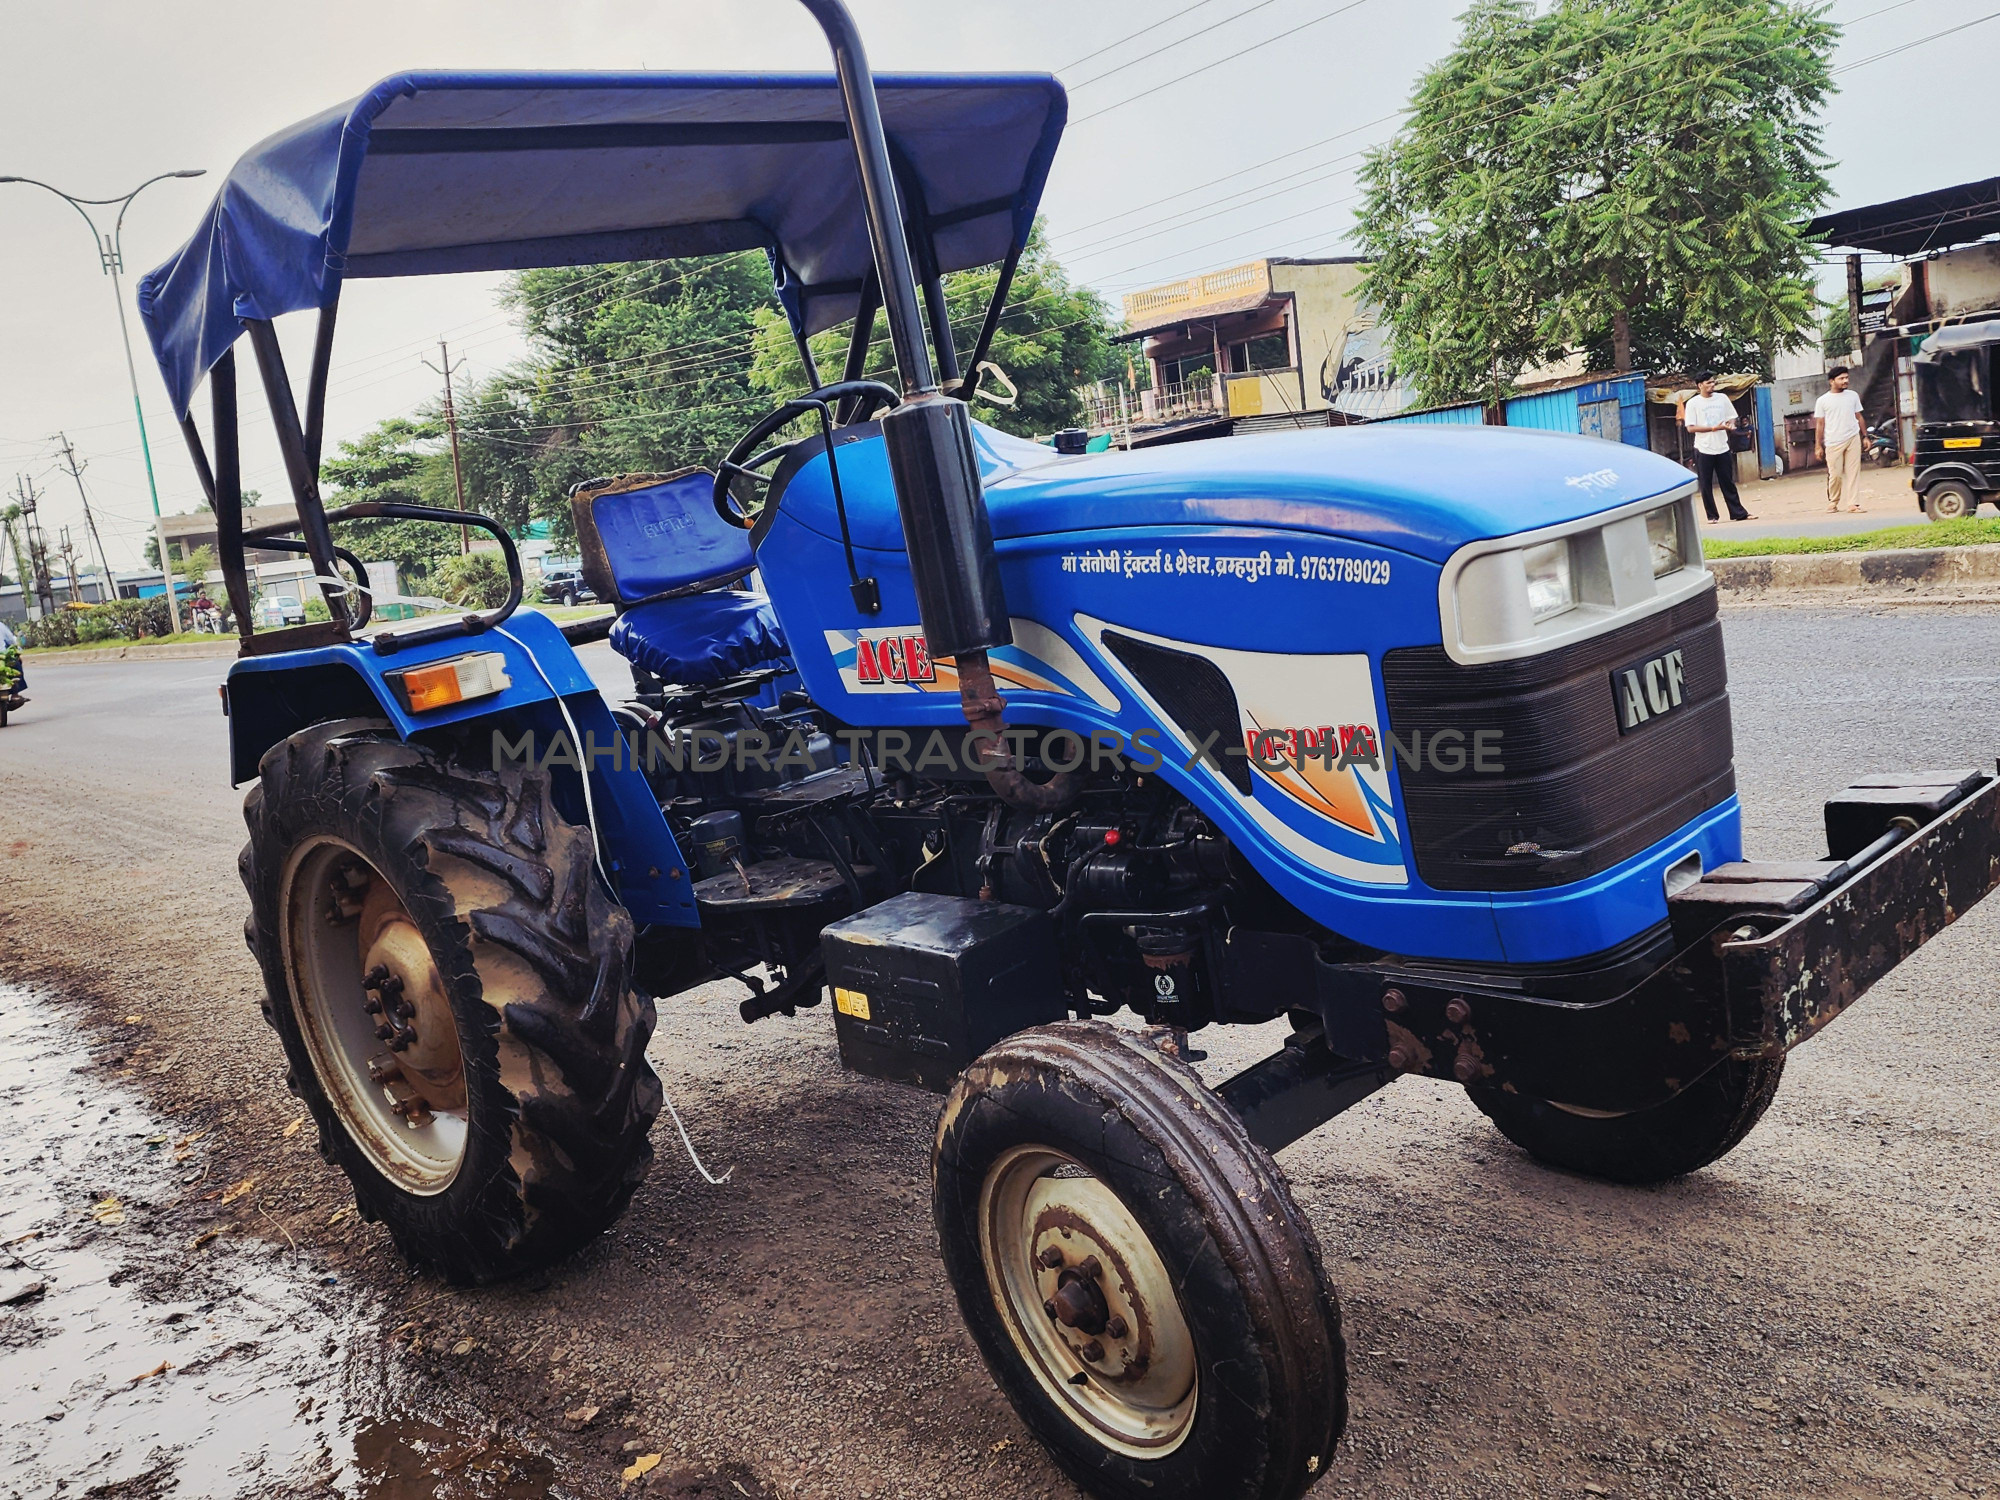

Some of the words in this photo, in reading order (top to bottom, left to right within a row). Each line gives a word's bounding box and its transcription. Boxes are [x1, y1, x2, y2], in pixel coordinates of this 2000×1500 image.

[1078, 549, 1121, 573] संतोषी
[1164, 553, 1174, 574] &
[857, 636, 936, 684] ACE
